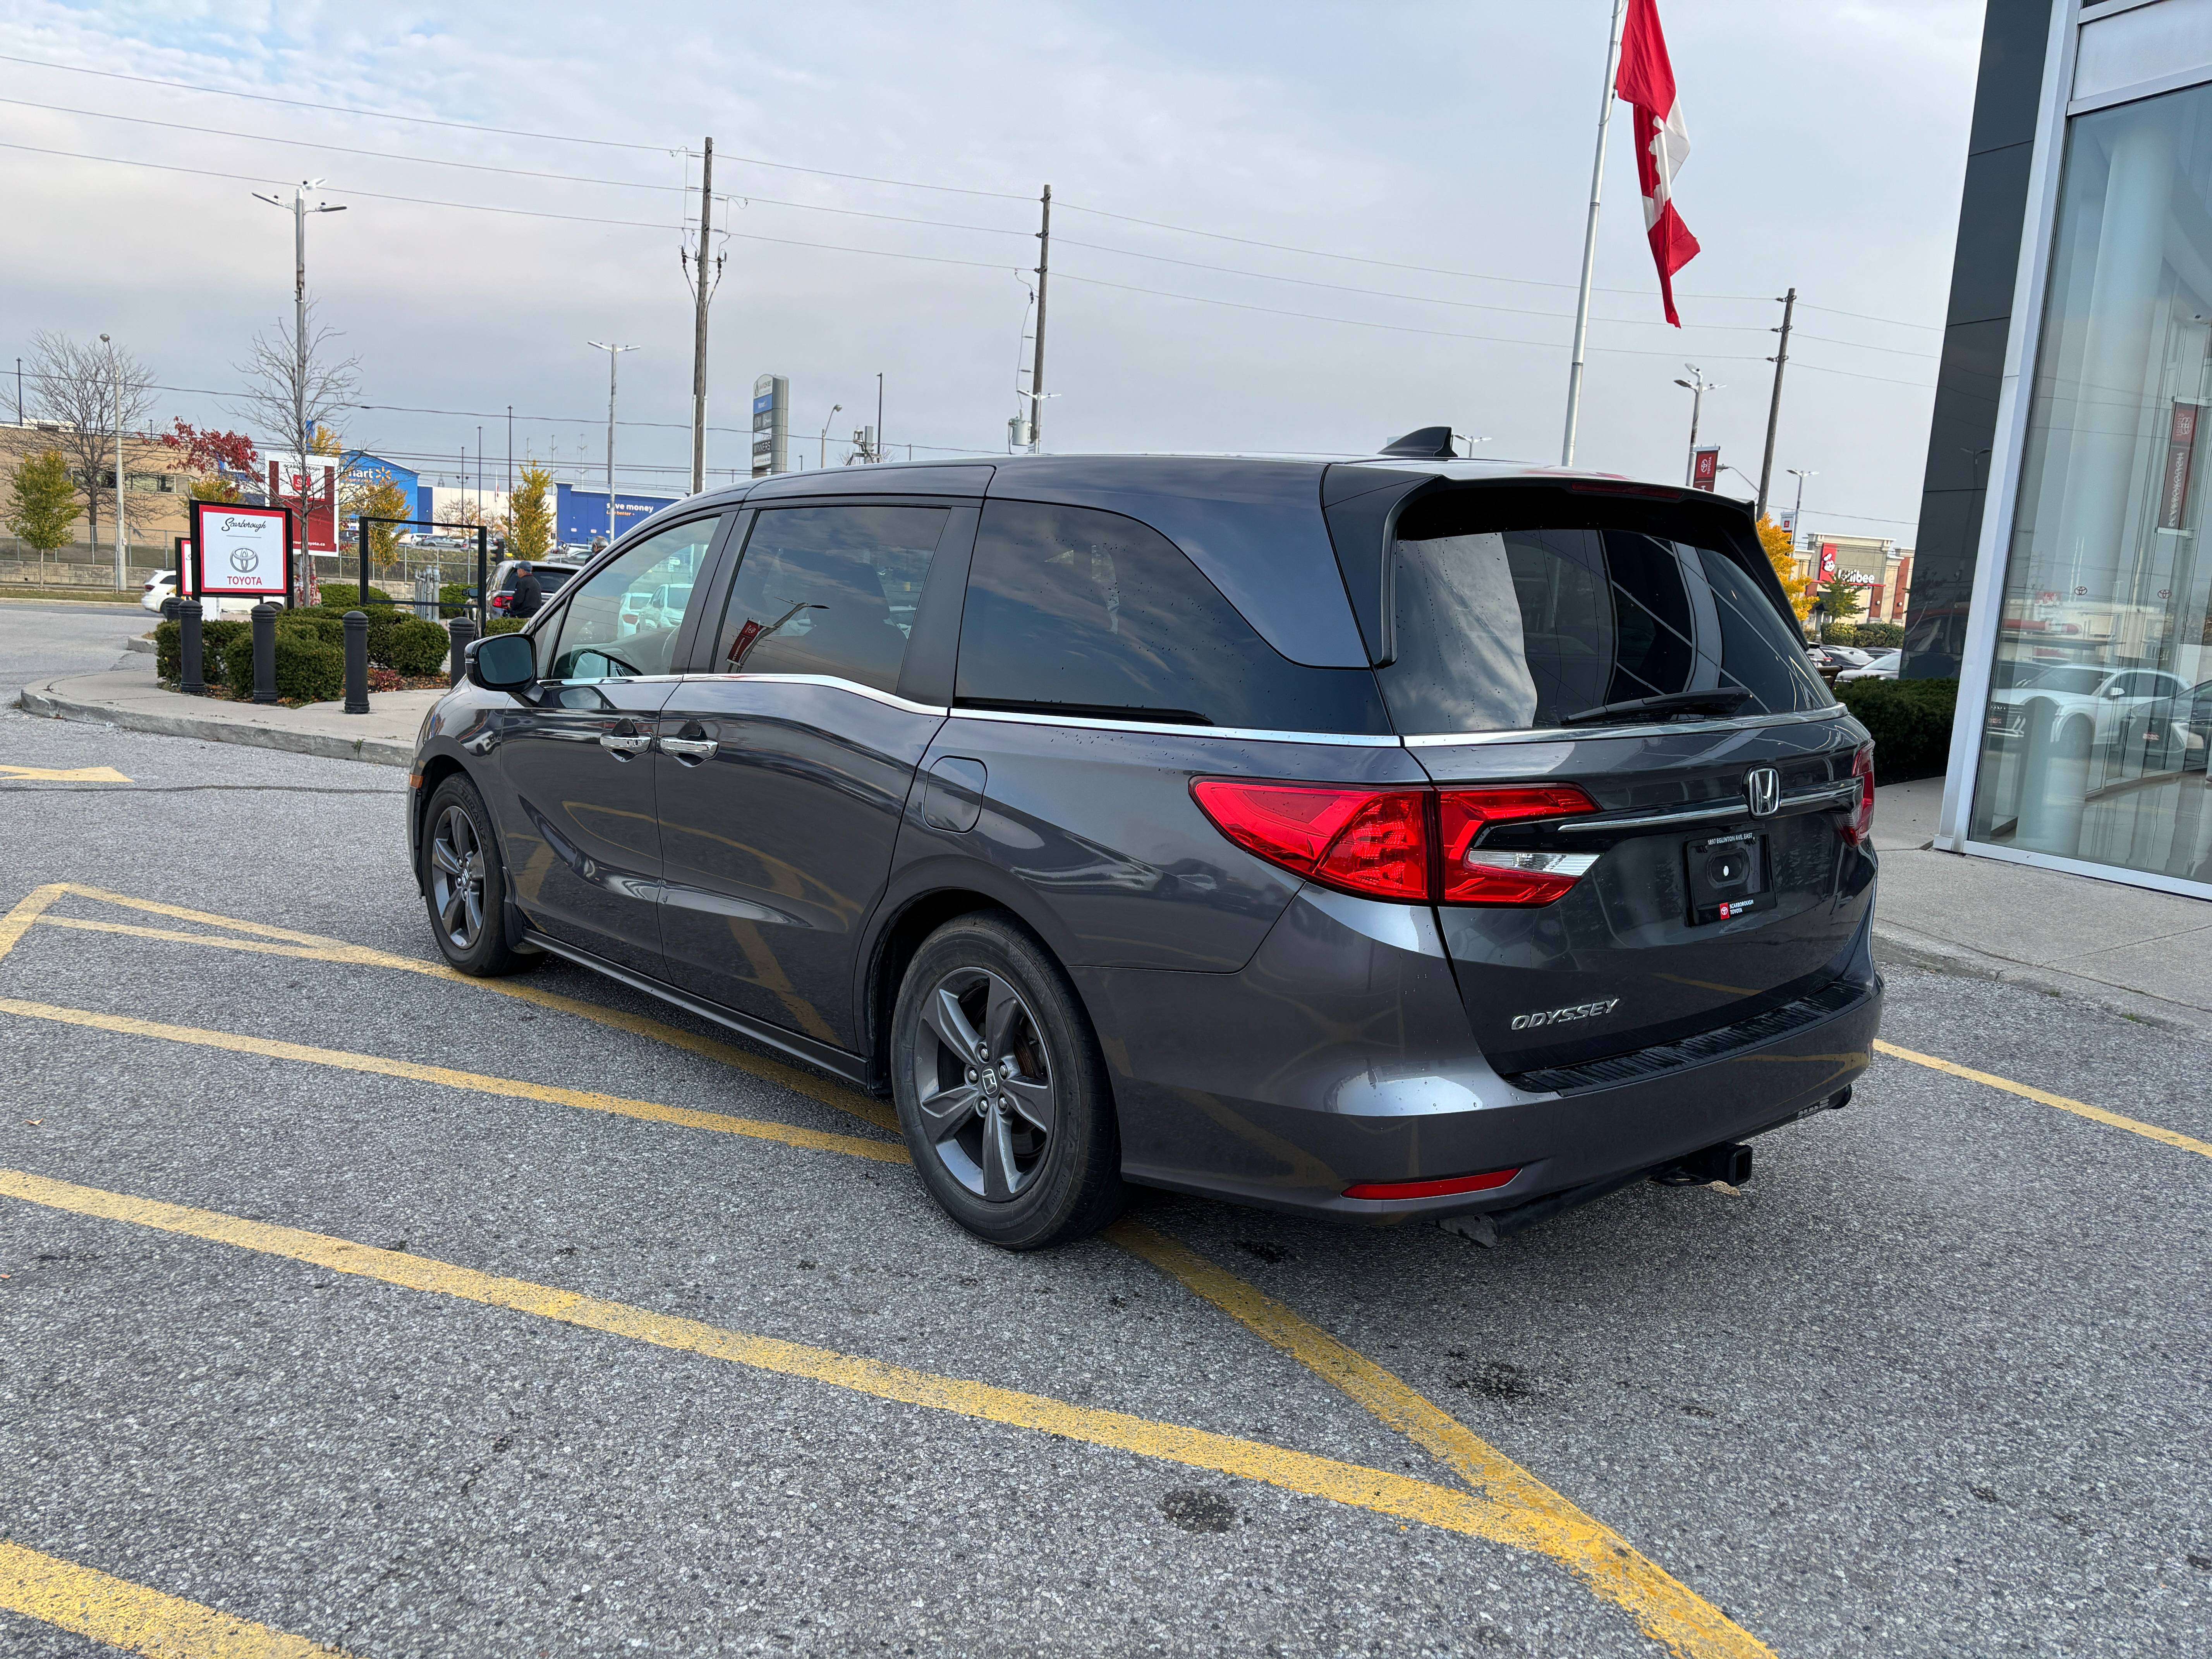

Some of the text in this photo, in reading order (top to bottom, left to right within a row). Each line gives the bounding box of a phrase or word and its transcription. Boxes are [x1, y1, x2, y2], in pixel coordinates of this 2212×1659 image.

[626, 504, 654, 513] money
[221, 517, 266, 532] Scarborough
[227, 576, 263, 585] TOYOTA
[1716, 835, 1735, 844] EGLINTON
[1729, 899, 1754, 909] SCARBOROUGH
[1511, 998, 1620, 1030] ODYSSEY
